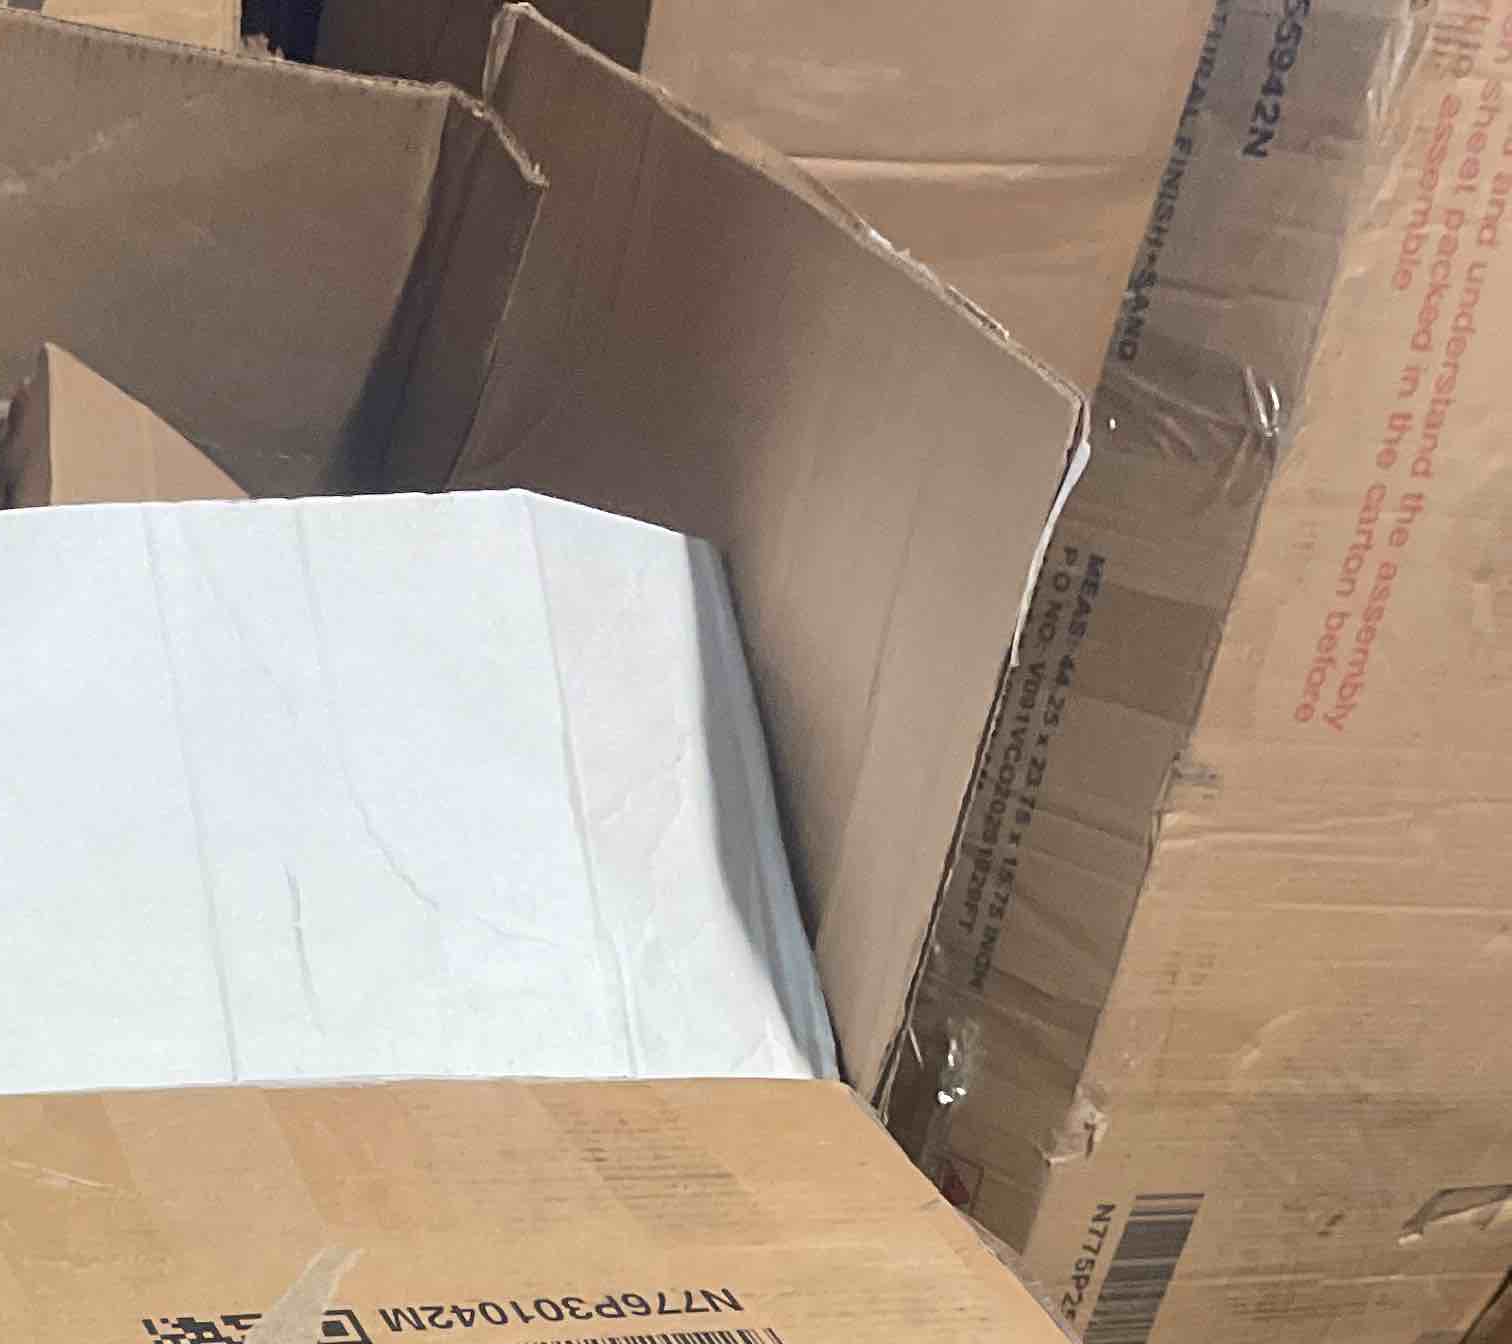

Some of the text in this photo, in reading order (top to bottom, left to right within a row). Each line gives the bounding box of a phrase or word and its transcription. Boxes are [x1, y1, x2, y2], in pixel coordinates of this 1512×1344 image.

[1392, 93, 1462, 291] assemble
[1410, 208, 1466, 353] packed
[1410, 263, 1487, 480] understand
[1375, 411, 1414, 470] the
[1335, 483, 1387, 599] carton
[1389, 491, 1425, 548] the
[1293, 609, 1352, 724] before
[1323, 561, 1398, 732] assembly
[377, 1286, 747, 1333] N776P301042M
